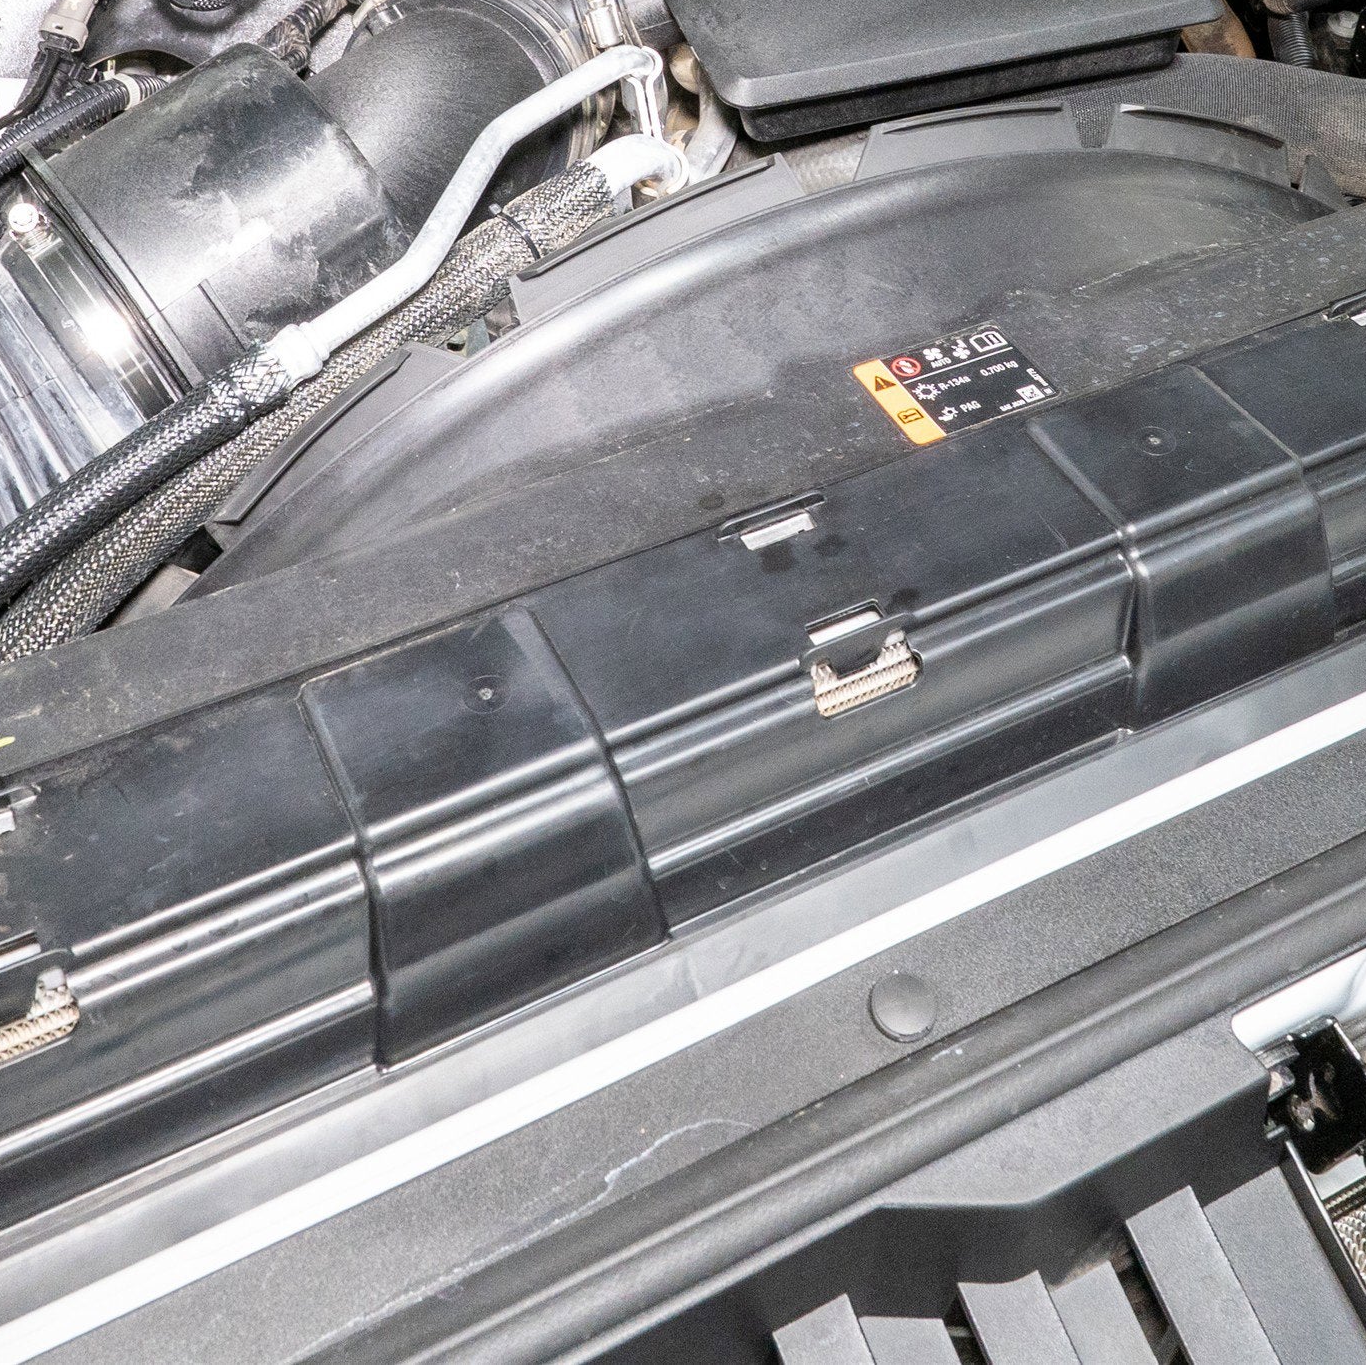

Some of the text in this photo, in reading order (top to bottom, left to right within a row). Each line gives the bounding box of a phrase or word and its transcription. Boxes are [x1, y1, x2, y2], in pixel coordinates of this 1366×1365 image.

[931, 357, 952, 368] AUTO
[938, 360, 1019, 391] R-134a 0.700 kg
[960, 400, 982, 414] PAG
